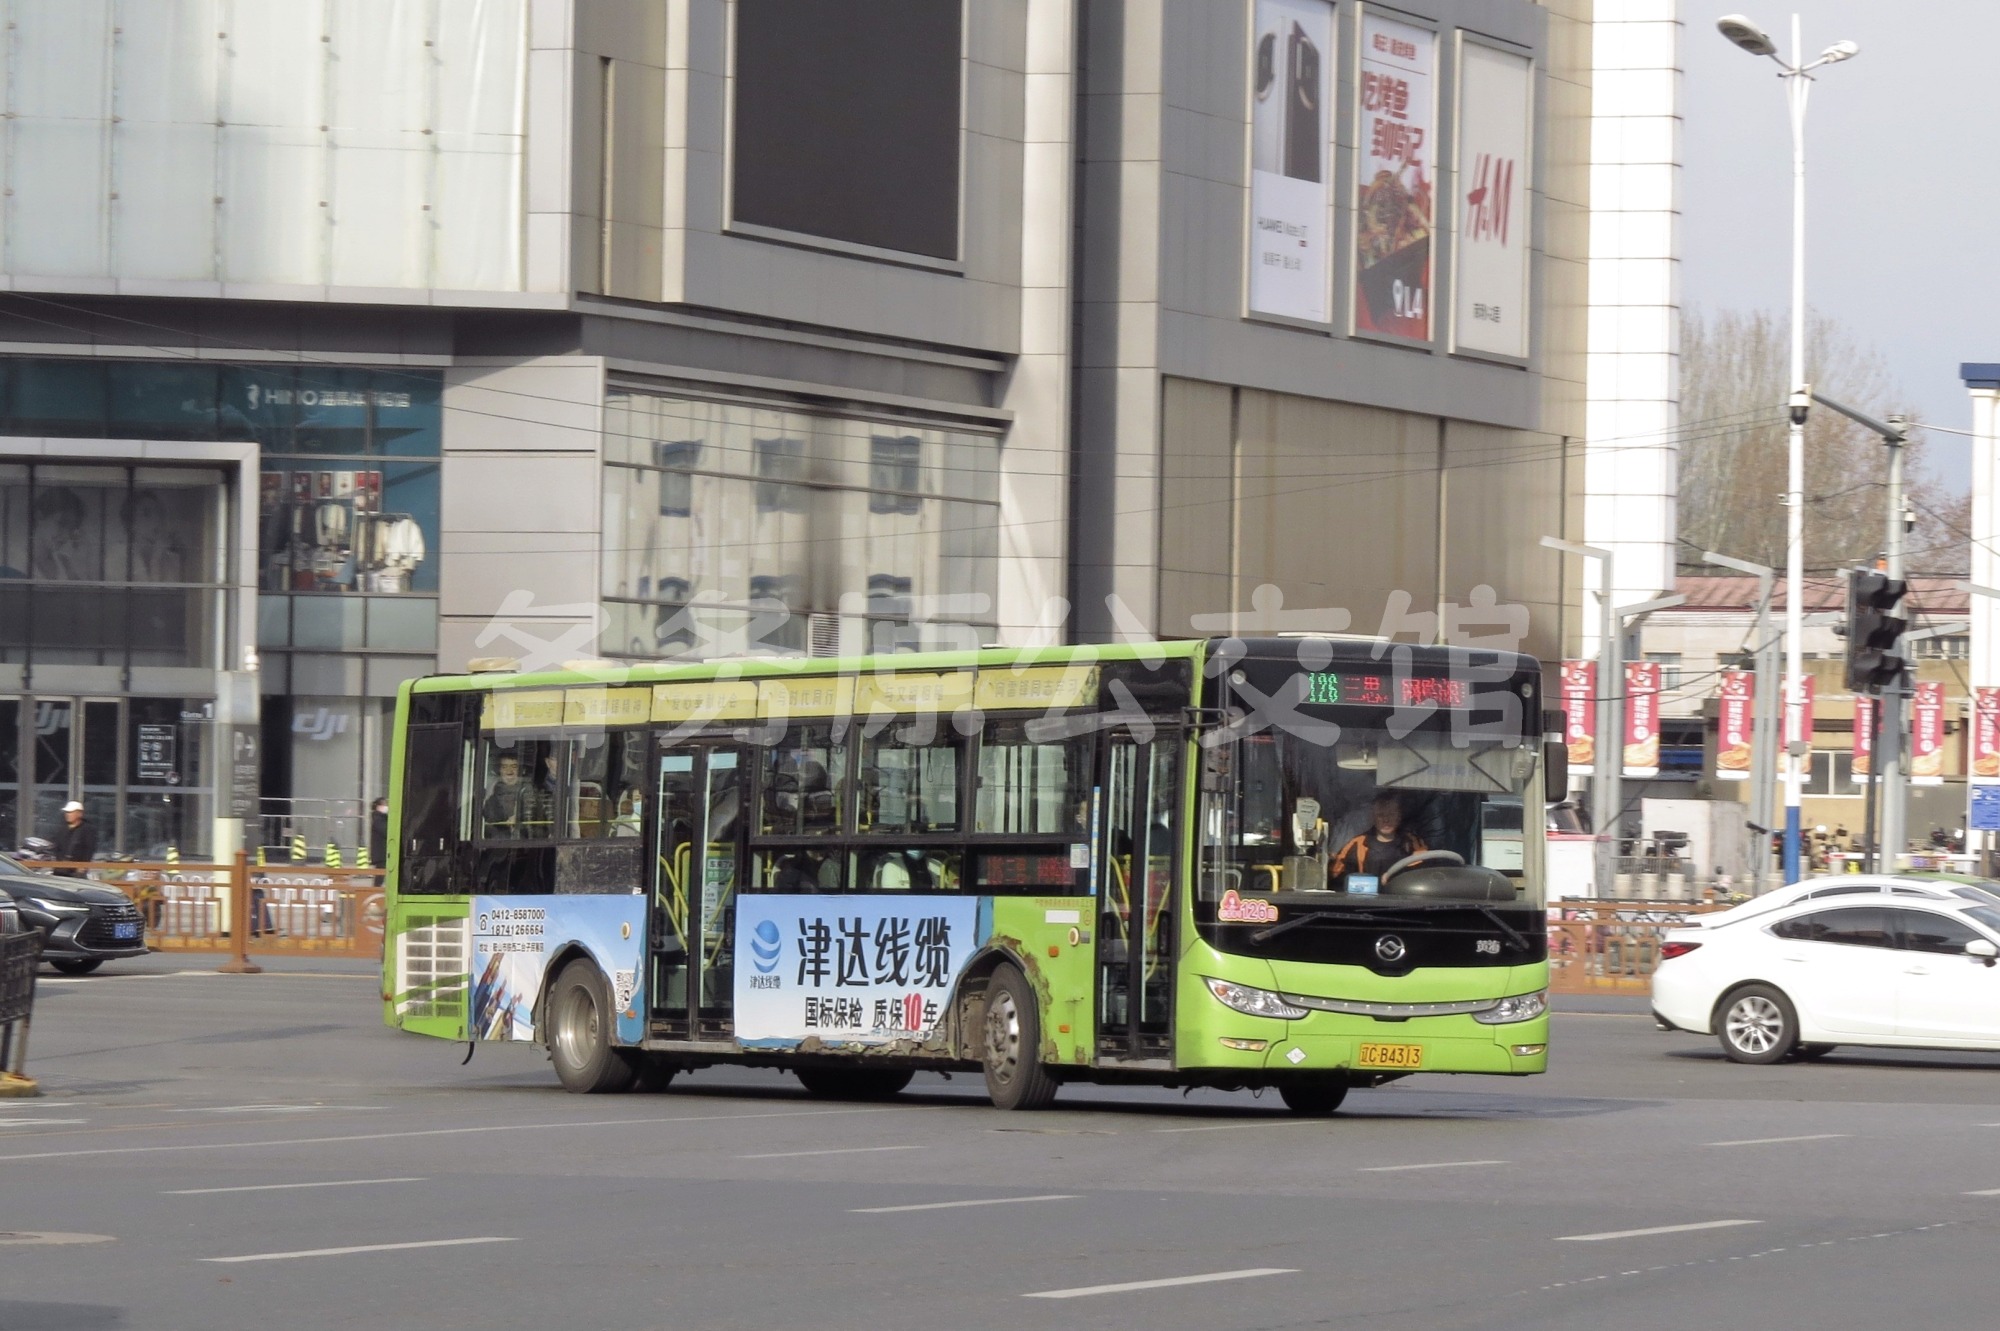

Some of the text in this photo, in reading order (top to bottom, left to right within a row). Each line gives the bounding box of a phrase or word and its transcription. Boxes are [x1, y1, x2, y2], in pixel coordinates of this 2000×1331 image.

[1465, 152, 1514, 248] H&M
[1403, 286, 1423, 319] L4
[491, 908, 546, 921] 0412-8587000
[1241, 902, 1267, 920] 126
[491, 924, 544, 936] 18741266664
[797, 916, 952, 989] 津达线缆
[749, 975, 781, 990] 津达线缆
[872, 992, 939, 1032] 质保10年
